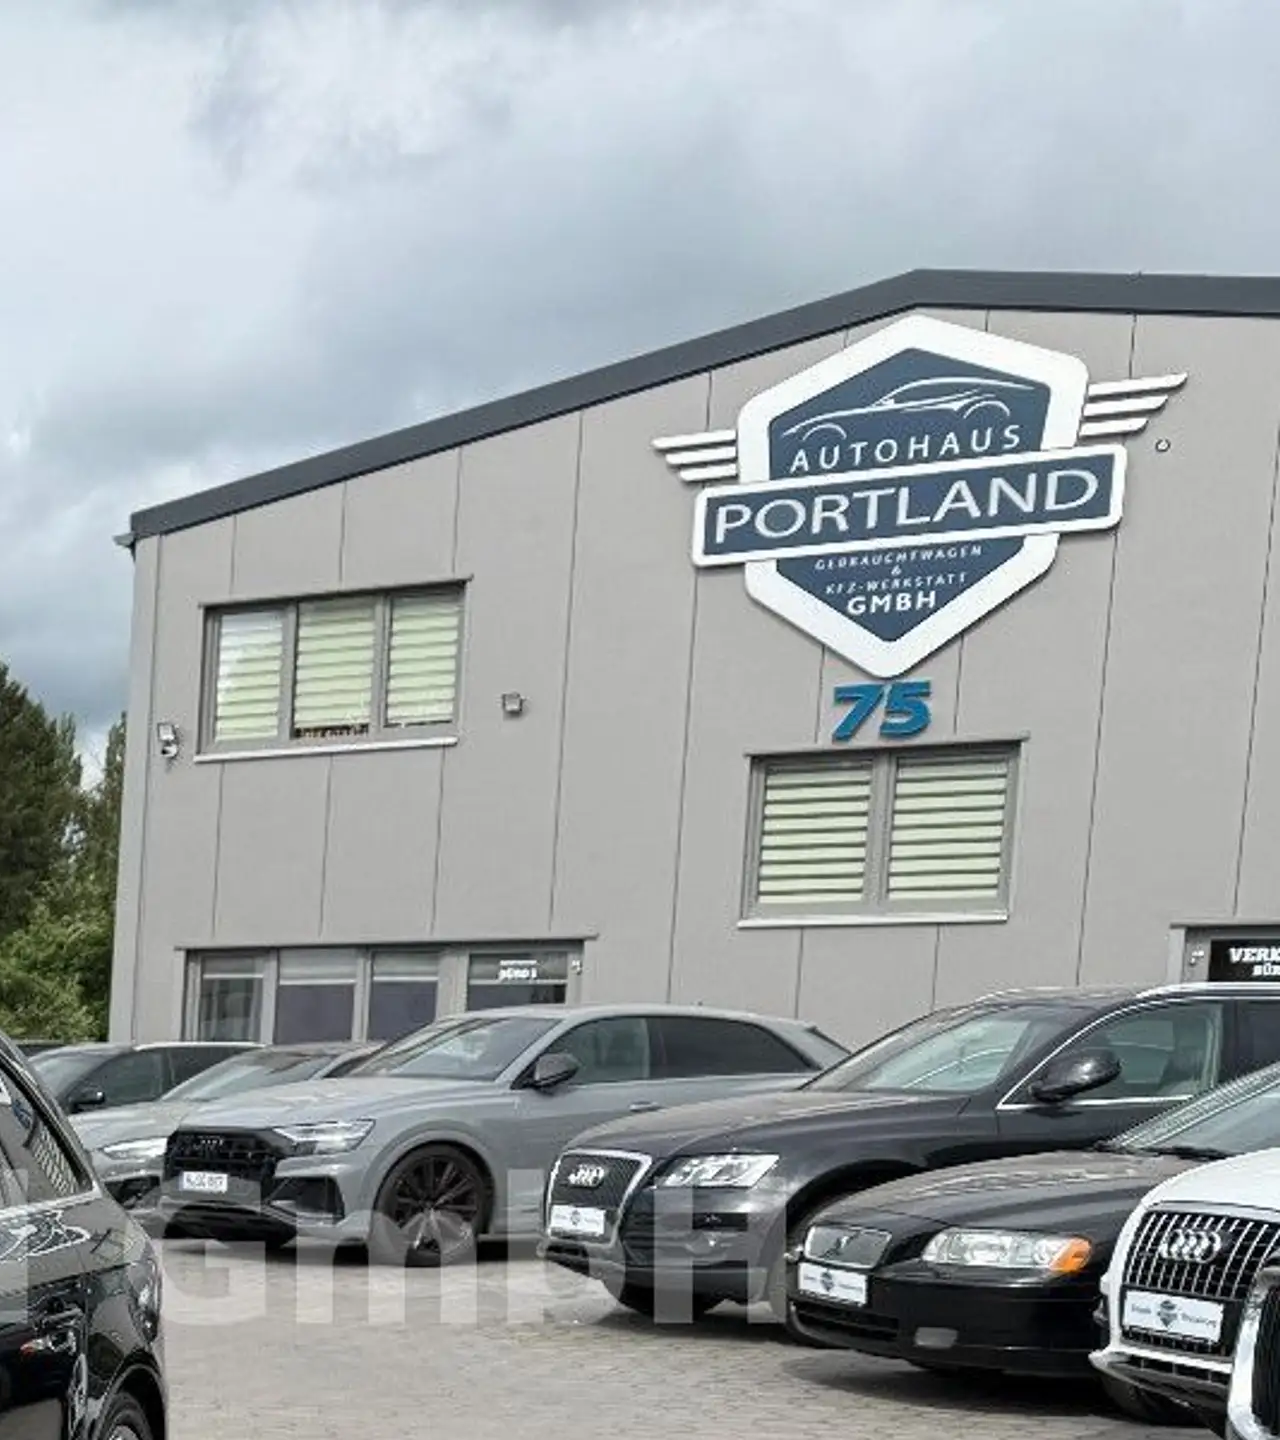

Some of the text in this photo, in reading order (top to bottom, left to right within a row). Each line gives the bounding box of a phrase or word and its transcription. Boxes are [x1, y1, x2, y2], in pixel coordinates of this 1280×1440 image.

[789, 423, 1023, 475] AUTOHAUS
[714, 468, 1100, 545] PORTLAND
[846, 590, 937, 615] GMBH
[831, 680, 933, 743] 75
